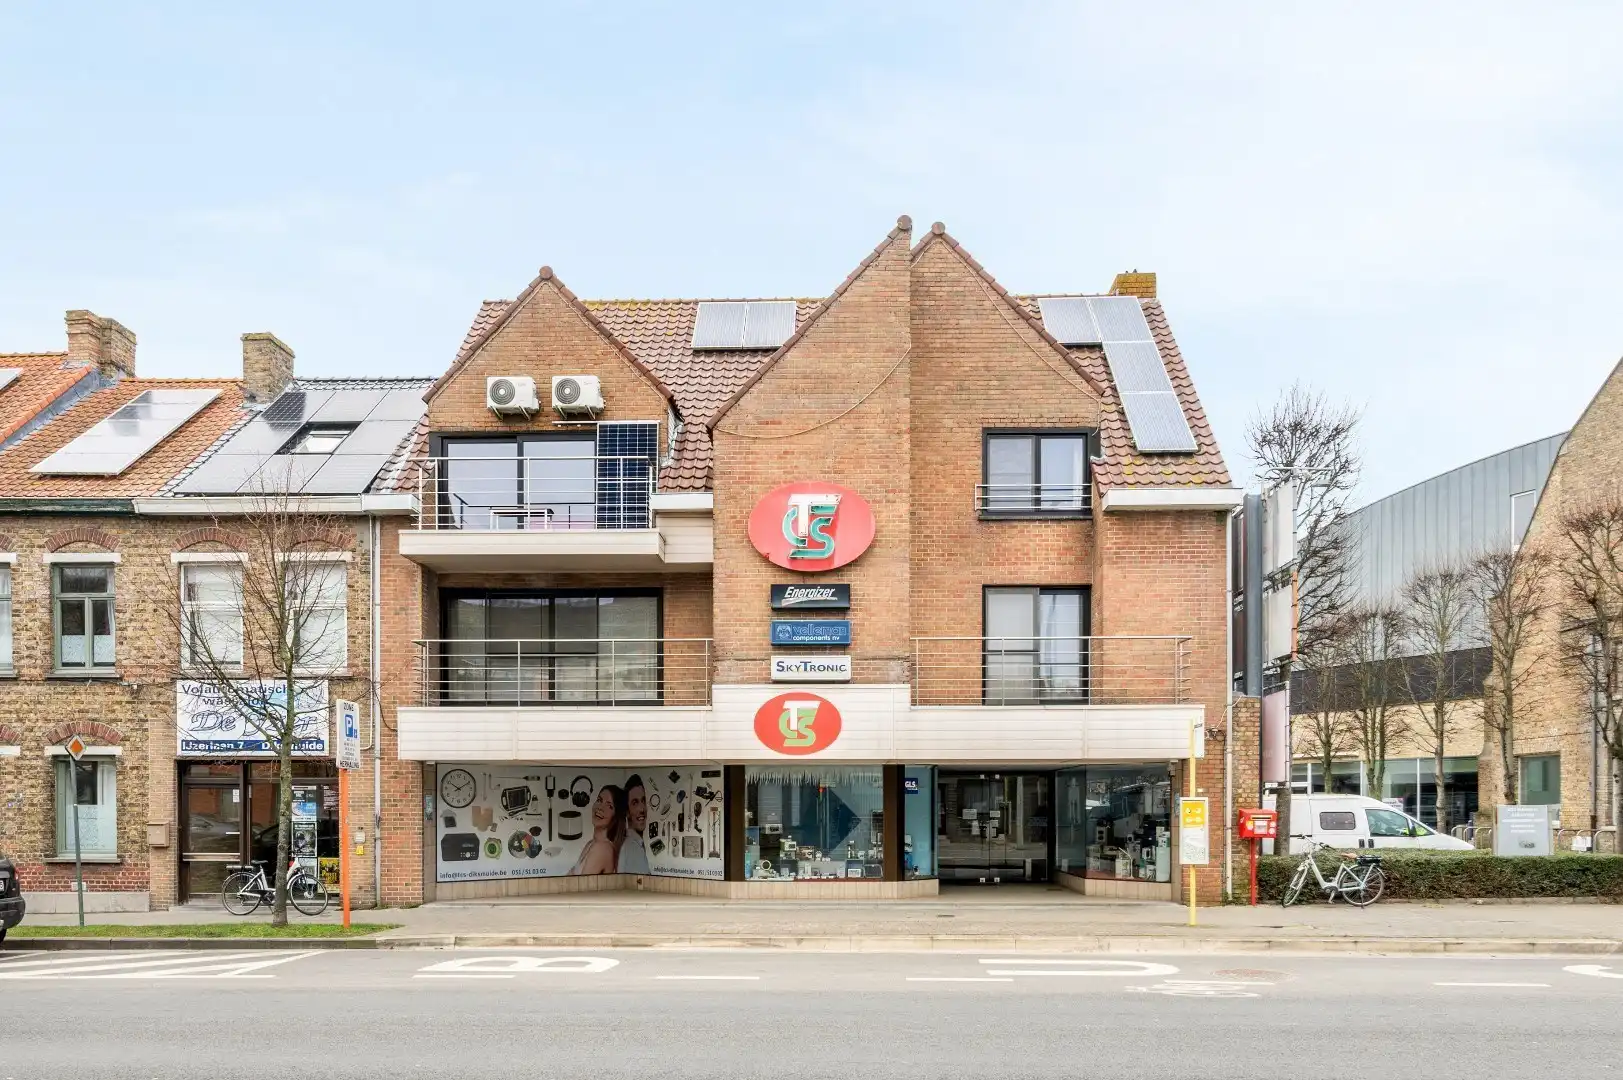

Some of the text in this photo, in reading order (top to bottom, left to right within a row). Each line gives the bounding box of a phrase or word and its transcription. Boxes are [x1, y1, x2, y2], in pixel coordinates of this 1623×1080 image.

[784, 586, 836, 599] Energizer
[793, 624, 847, 635] velleman
[188, 710, 237, 732] De
[262, 740, 324, 750] Dkmuide
